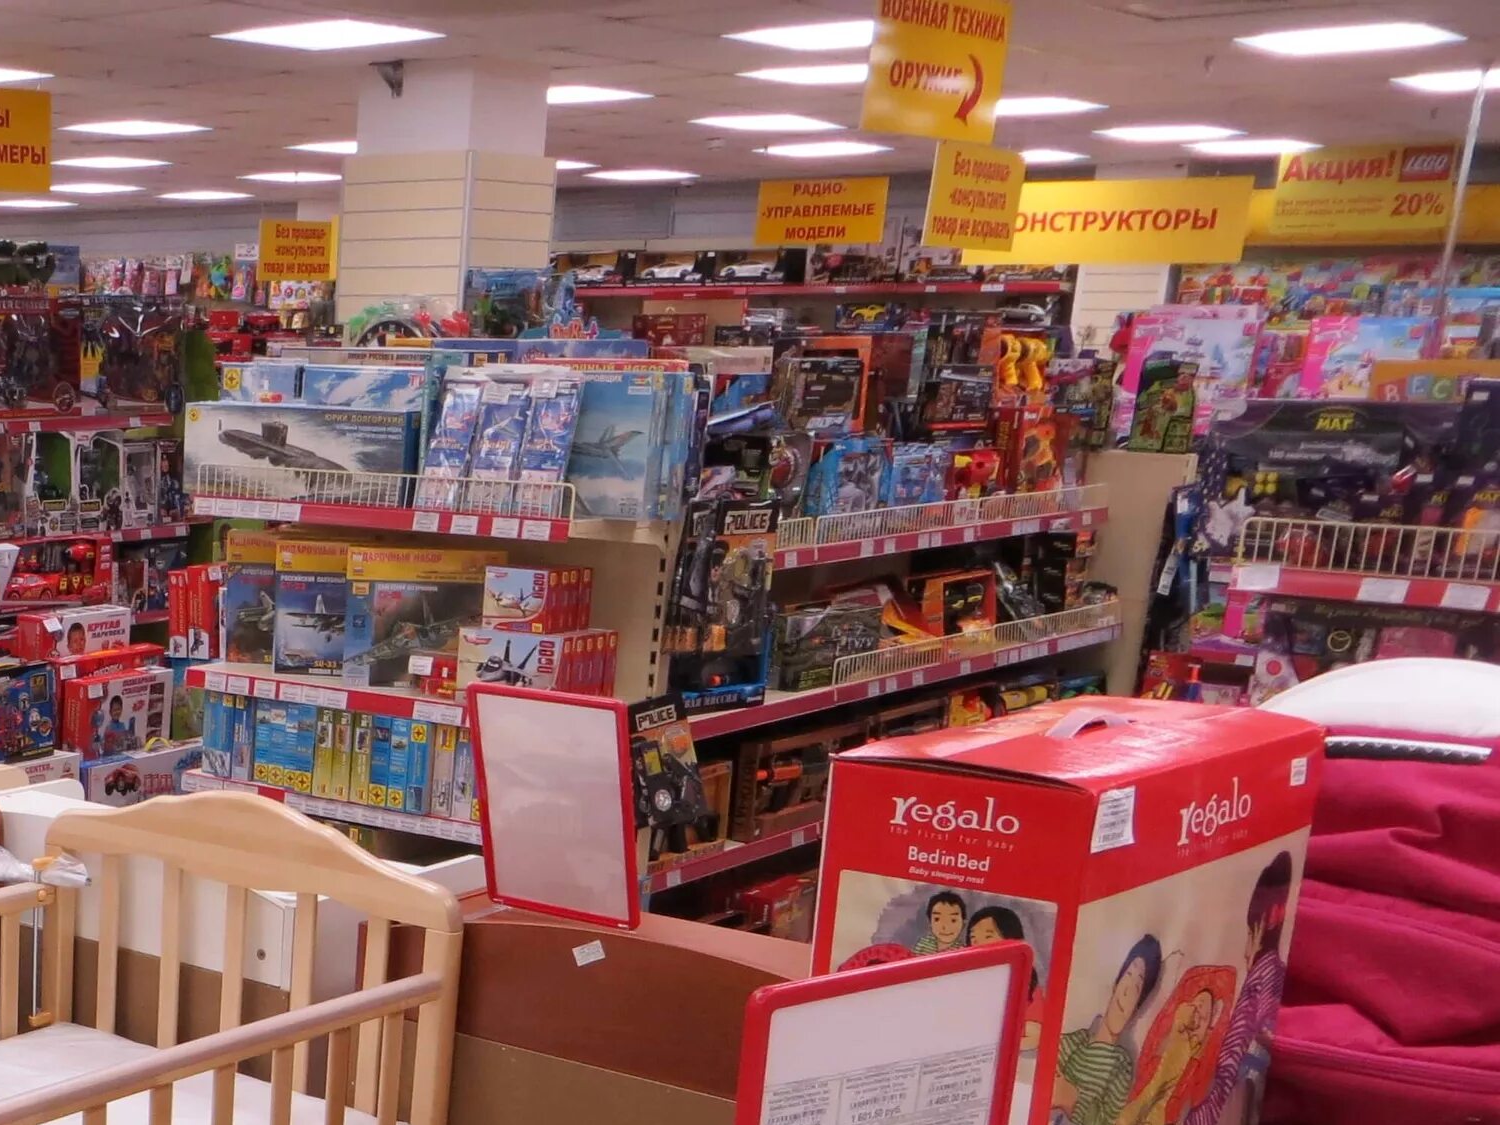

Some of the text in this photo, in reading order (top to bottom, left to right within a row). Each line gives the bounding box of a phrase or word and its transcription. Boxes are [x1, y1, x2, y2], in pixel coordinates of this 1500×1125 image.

[952, 5, 1005, 42] ТЕХНИКА
[1282, 150, 1398, 185] Акция!
[1404, 154, 1449, 172] LEGO
[1390, 192, 1445, 217] 20%
[1014, 208, 1218, 234] ОНСТРУКТОРЫ
[785, 226, 847, 241] МОДЕЛИ
[1315, 415, 1355, 432] МАГ
[725, 511, 770, 533] POLICE
[87, 619, 121, 632] КРУТАЯ
[91, 630, 126, 639] ПАРКОВКА
[637, 706, 675, 730] POLICE
[889, 796, 1020, 835] regalo
[1177, 776, 1252, 846] regalo
